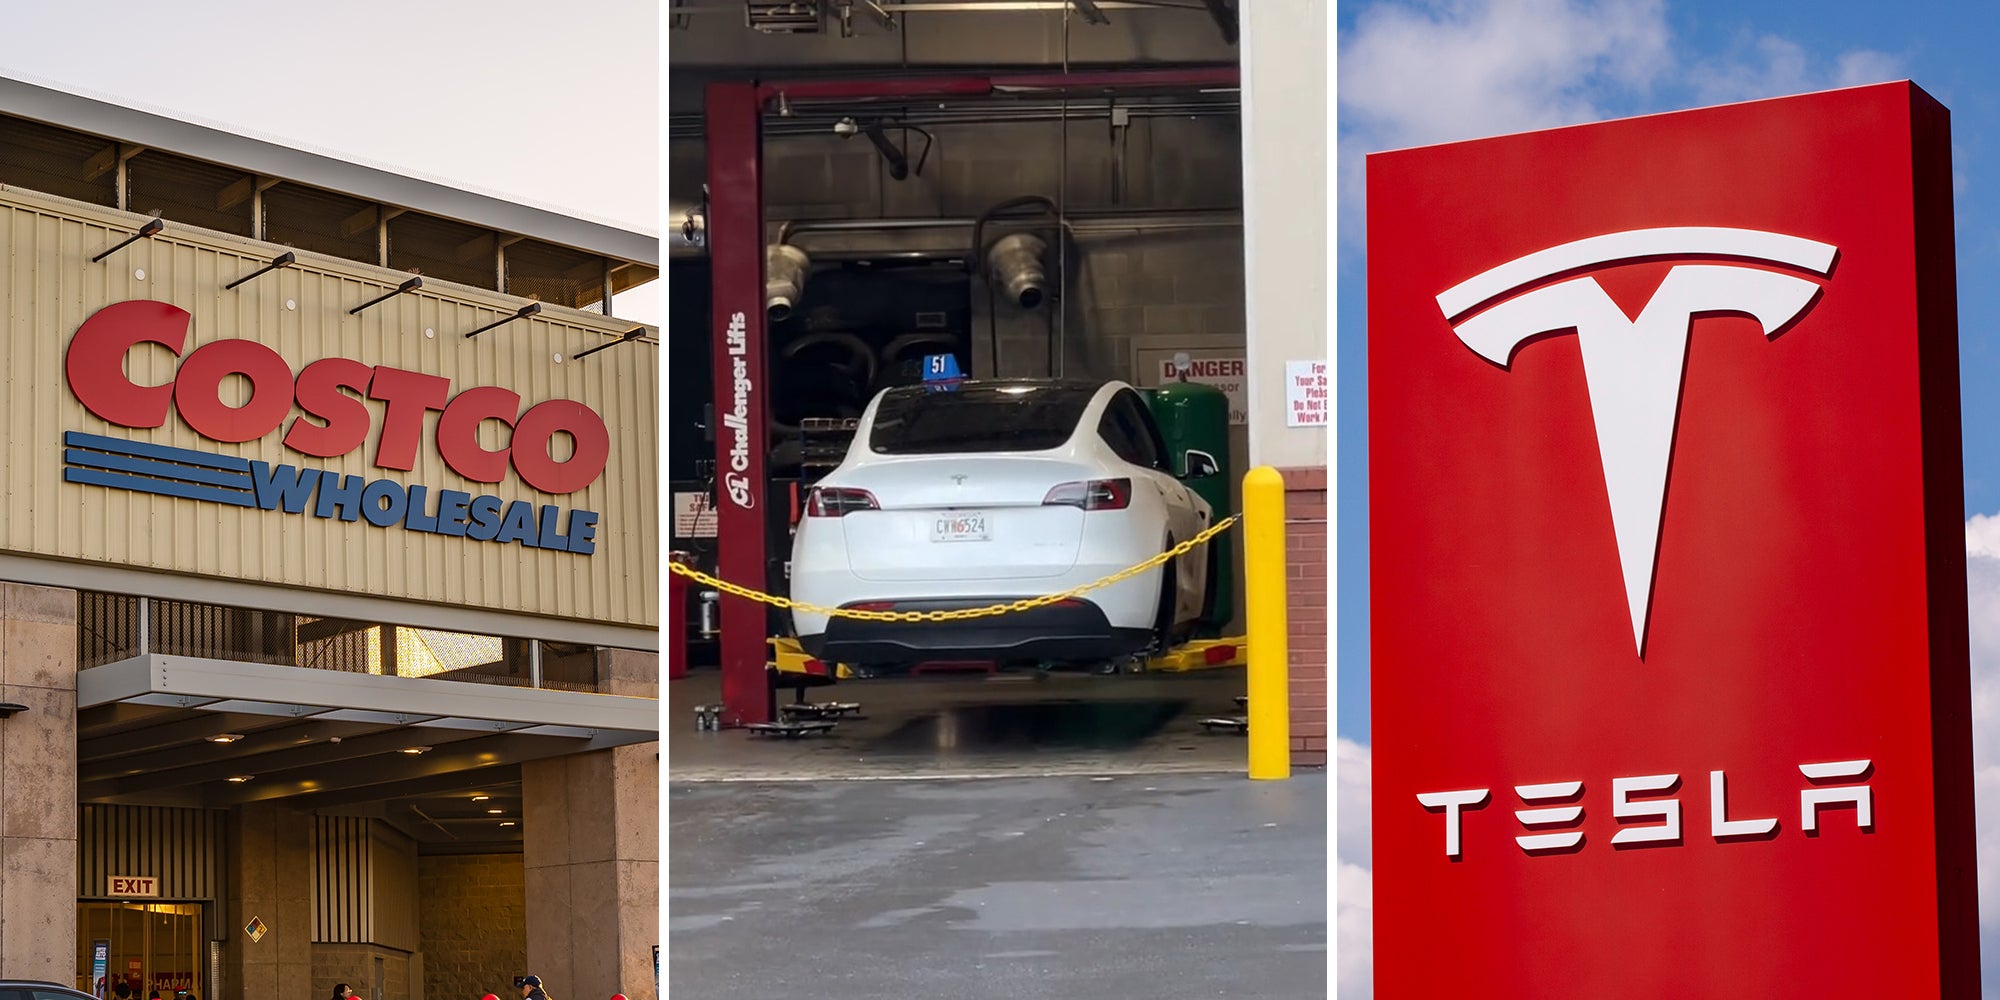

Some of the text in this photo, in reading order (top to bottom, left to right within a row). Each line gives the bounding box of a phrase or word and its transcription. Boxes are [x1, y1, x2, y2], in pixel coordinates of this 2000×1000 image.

[727, 311, 746, 355] Lifts
[931, 355, 945, 374] 51
[1312, 363, 1326, 374] For
[1295, 375, 1314, 386] Your
[66, 300, 609, 494] COSTCO
[1293, 400, 1304, 411] Do
[1307, 400, 1321, 410] Not
[724, 357, 752, 471] Challenger
[1297, 412, 1320, 423] Work
[250, 460, 598, 555] WHOLESALE
[1416, 760, 1871, 855] TESLA
[113, 879, 153, 894] EXIT
